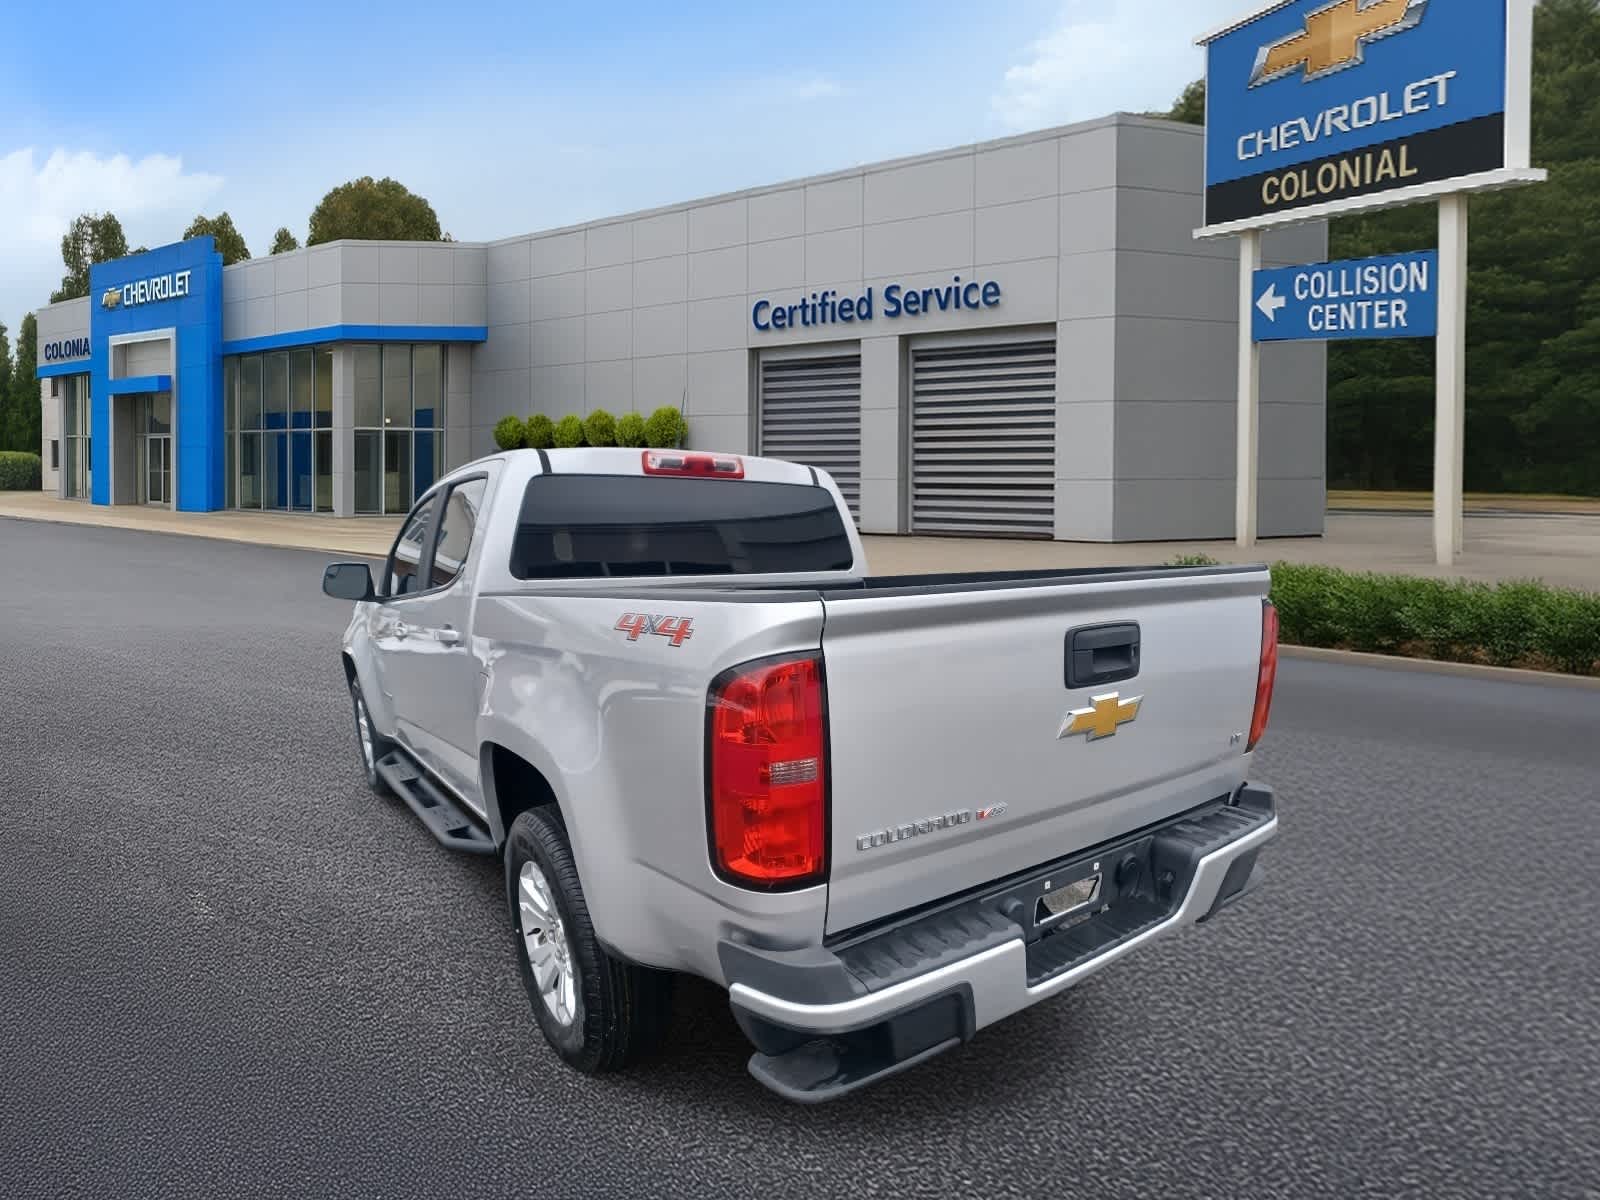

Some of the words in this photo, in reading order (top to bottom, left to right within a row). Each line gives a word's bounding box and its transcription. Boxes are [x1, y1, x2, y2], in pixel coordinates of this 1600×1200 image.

[1237, 71, 1457, 161] CHEVROLET
[1262, 145, 1418, 205] COLONIAL
[123, 270, 191, 307] CHEVROLET
[752, 287, 874, 331] Certified
[883, 275, 1001, 318] Service
[1294, 261, 1429, 301] COLLISION
[1308, 299, 1408, 331] CENTER
